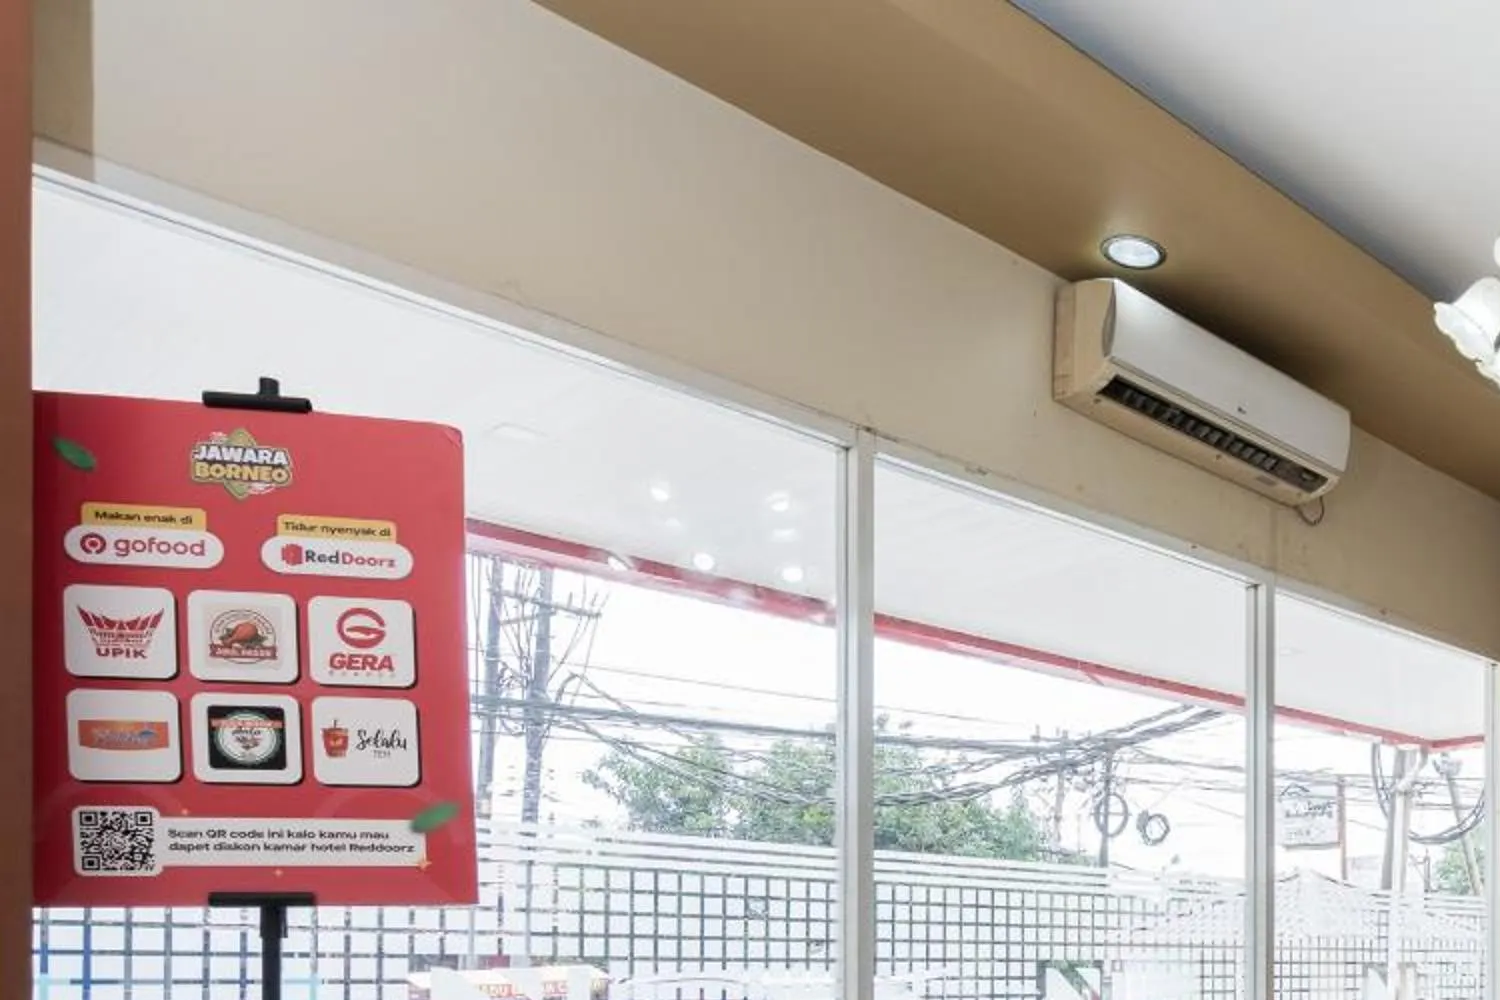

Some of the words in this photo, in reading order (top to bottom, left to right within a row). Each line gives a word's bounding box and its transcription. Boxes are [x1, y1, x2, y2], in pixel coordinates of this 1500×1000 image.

[194, 445, 289, 466] JAWARA
[195, 462, 291, 484] BORNEO
[93, 511, 141, 522] Makan
[144, 514, 176, 524] enak
[180, 515, 193, 525] di
[283, 521, 317, 531] Tidur
[320, 525, 376, 536] nyenyak
[379, 528, 391, 537] di
[113, 537, 206, 557] gofood
[305, 549, 396, 568] RedDoorz
[95, 647, 148, 660] UPIK
[329, 653, 395, 672] GERA
[168, 829, 203, 839] Scan
[206, 829, 227, 839] QR
[229, 830, 264, 839] code
[267, 829, 284, 839] ini
[287, 829, 317, 839] kalo
[319, 830, 357, 840] kamu
[360, 831, 389, 840] mau
[213, 842, 261, 852] diskon
[263, 842, 307, 853] kamar
[311, 843, 347, 853] hotel
